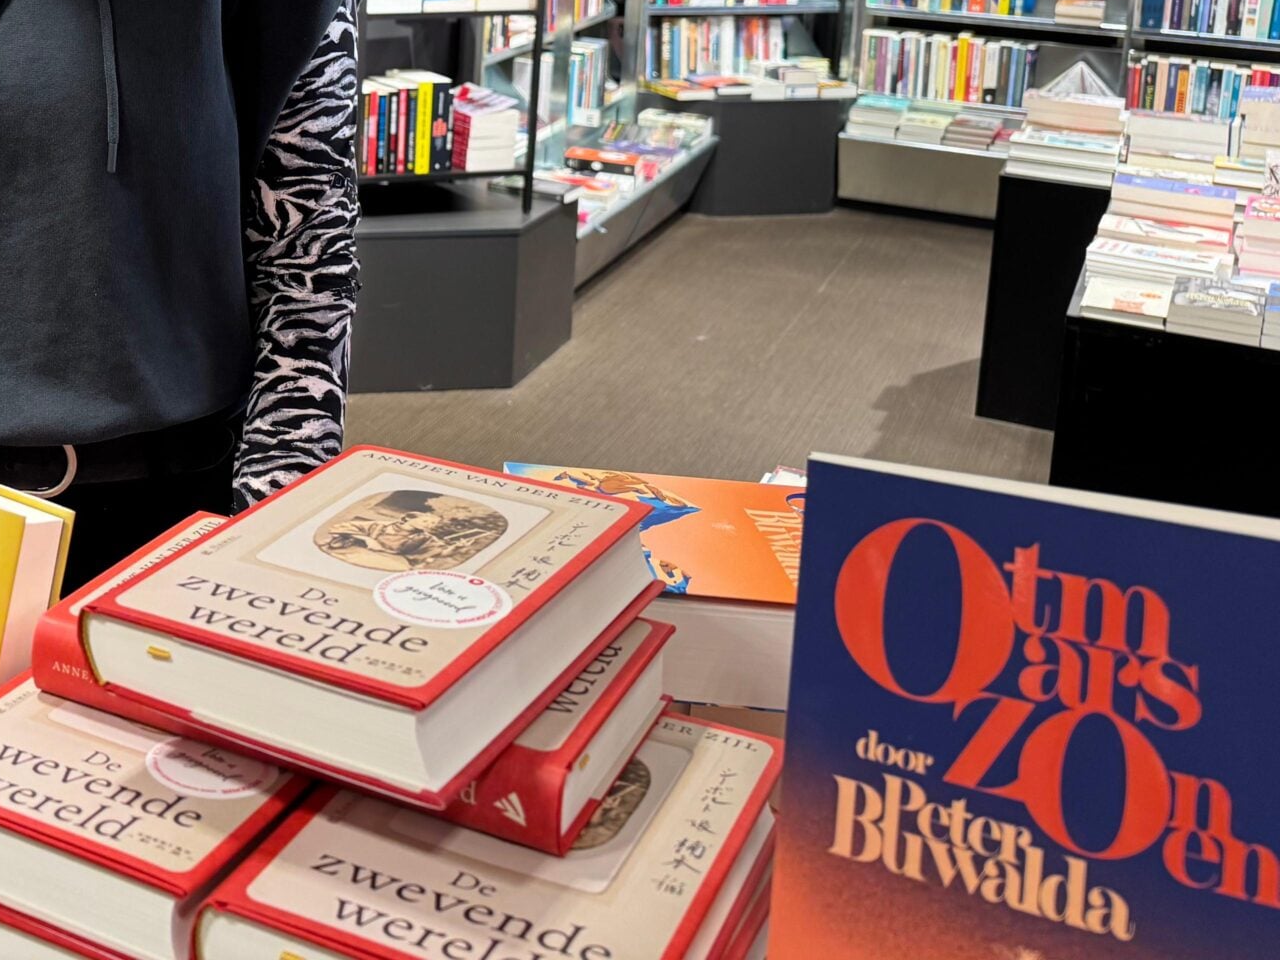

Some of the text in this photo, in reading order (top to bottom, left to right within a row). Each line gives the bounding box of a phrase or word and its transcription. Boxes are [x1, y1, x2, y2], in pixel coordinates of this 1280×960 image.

[363, 449, 616, 512] ANNEJET VAN DER ZIJL
[176, 575, 429, 654] zwevende
[295, 587, 340, 607] De
[189, 604, 366, 665] wereld
[82, 750, 122, 772] De
[656, 721, 758, 753] ER ZIJL
[855, 729, 935, 776] door
[881, 772, 1033, 863] Peter
[450, 870, 498, 898] De
[827, 773, 1137, 942] Buwalda
[309, 852, 613, 960] zwevende
